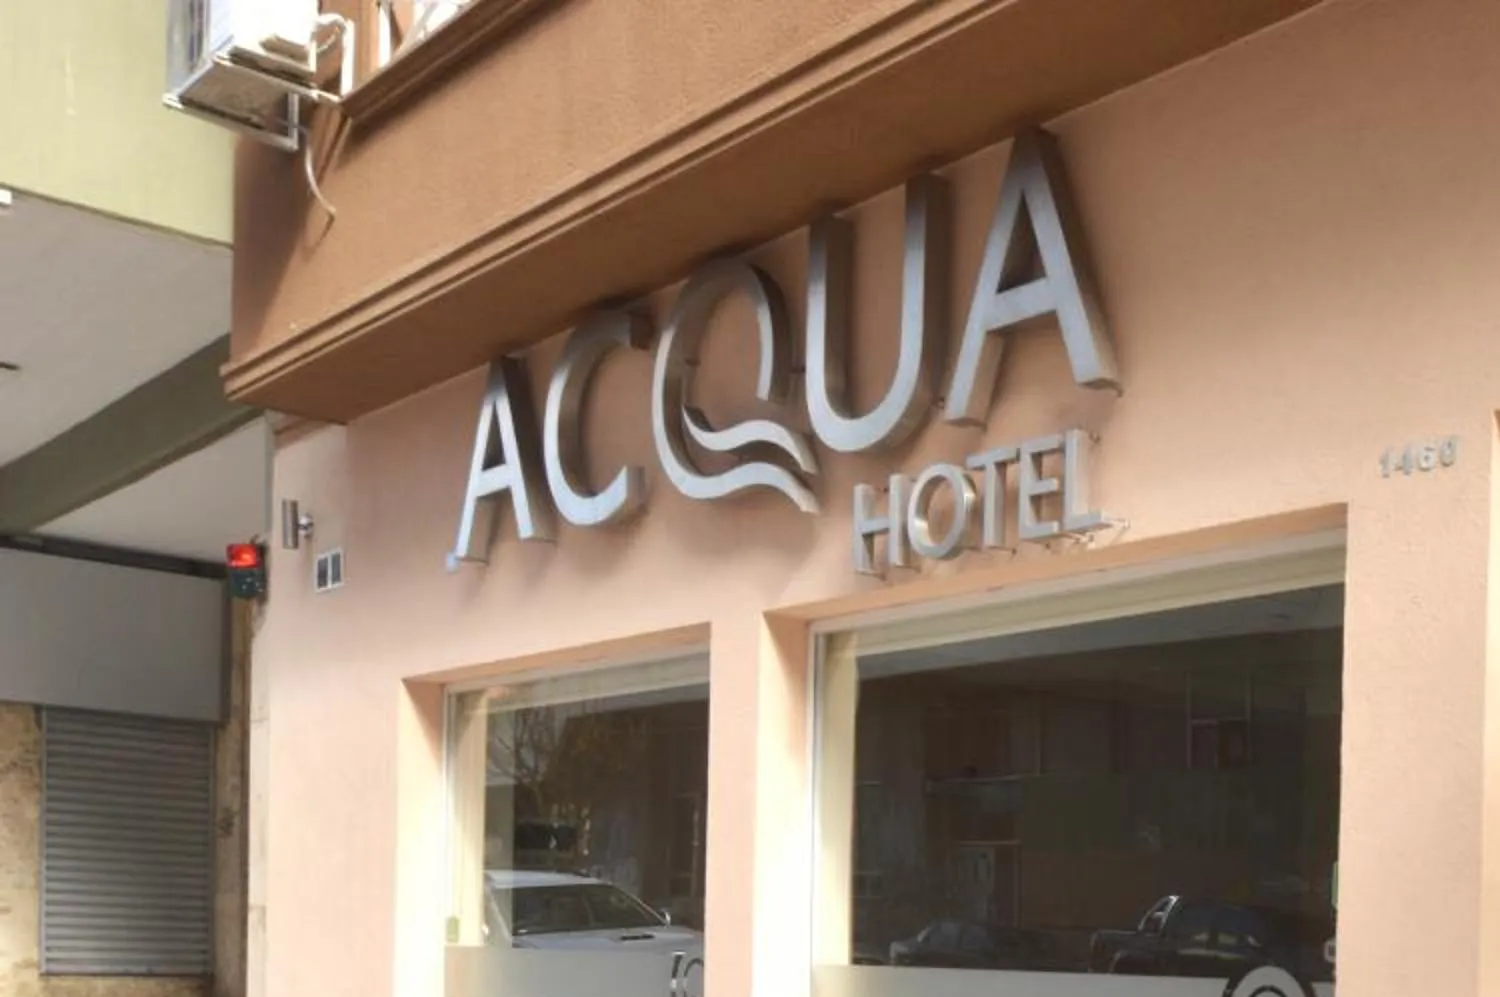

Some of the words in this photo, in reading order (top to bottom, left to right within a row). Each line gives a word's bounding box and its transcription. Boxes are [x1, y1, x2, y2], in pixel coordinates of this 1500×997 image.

[454, 126, 1118, 562] ACQUA
[853, 428, 1112, 574] HOTEL
[1379, 436, 1460, 478] 1460
